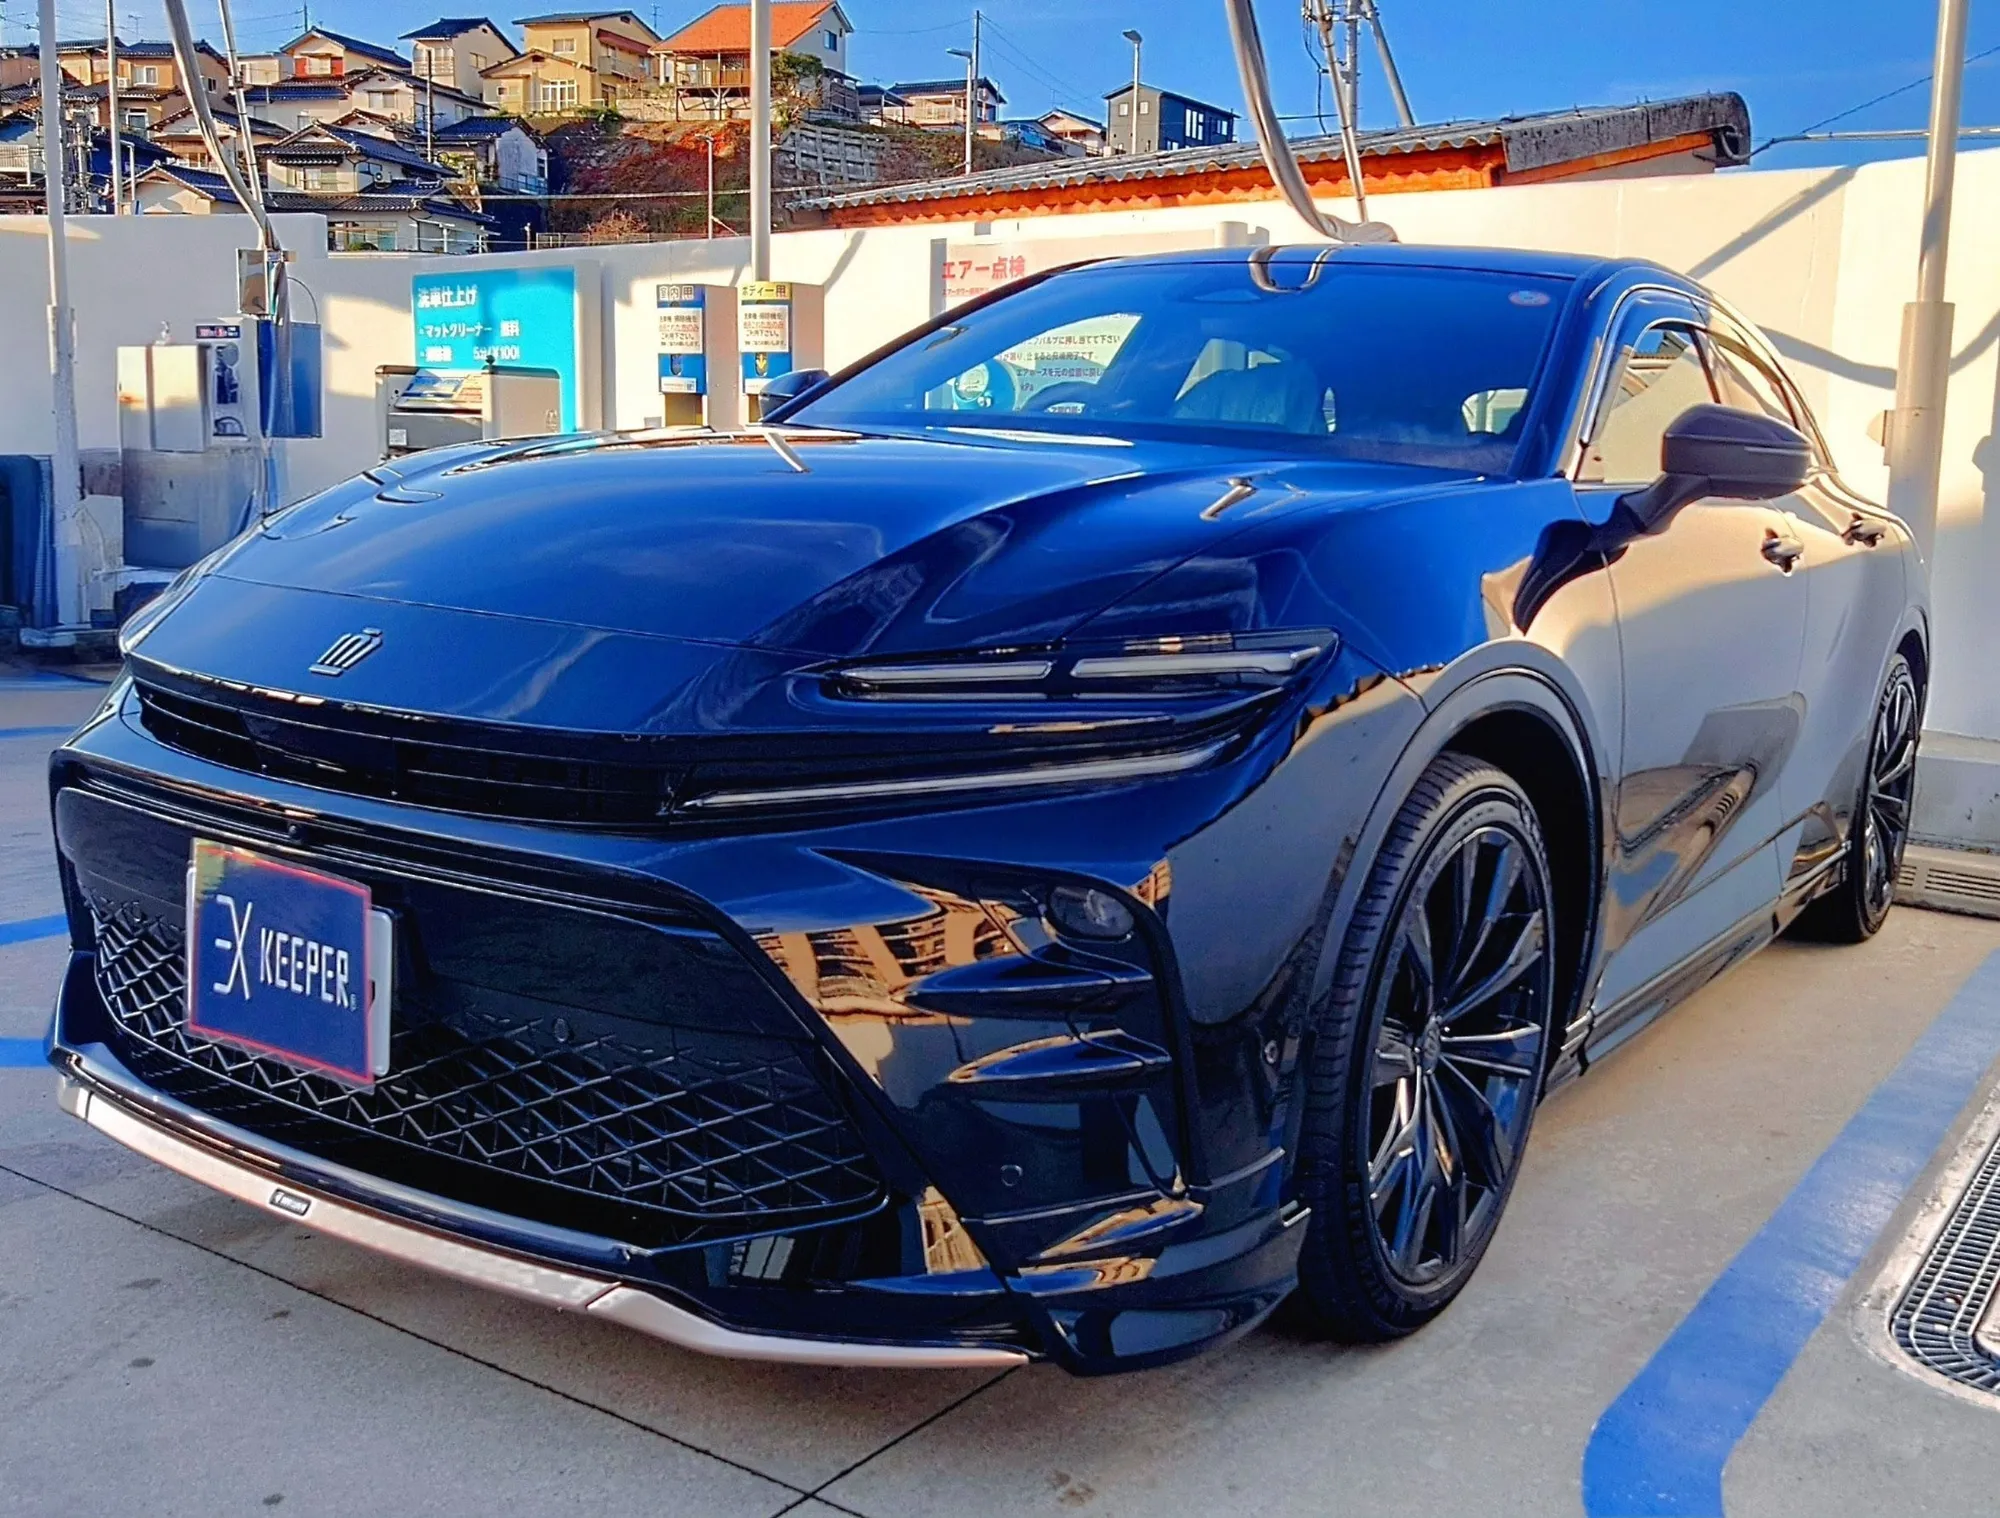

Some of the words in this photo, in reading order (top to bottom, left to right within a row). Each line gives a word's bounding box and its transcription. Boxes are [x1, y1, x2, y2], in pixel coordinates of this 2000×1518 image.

[942, 255, 1025, 279] エアー点検
[741, 284, 787, 299] ボディー用
[259, 927, 349, 1009] KEEPER
